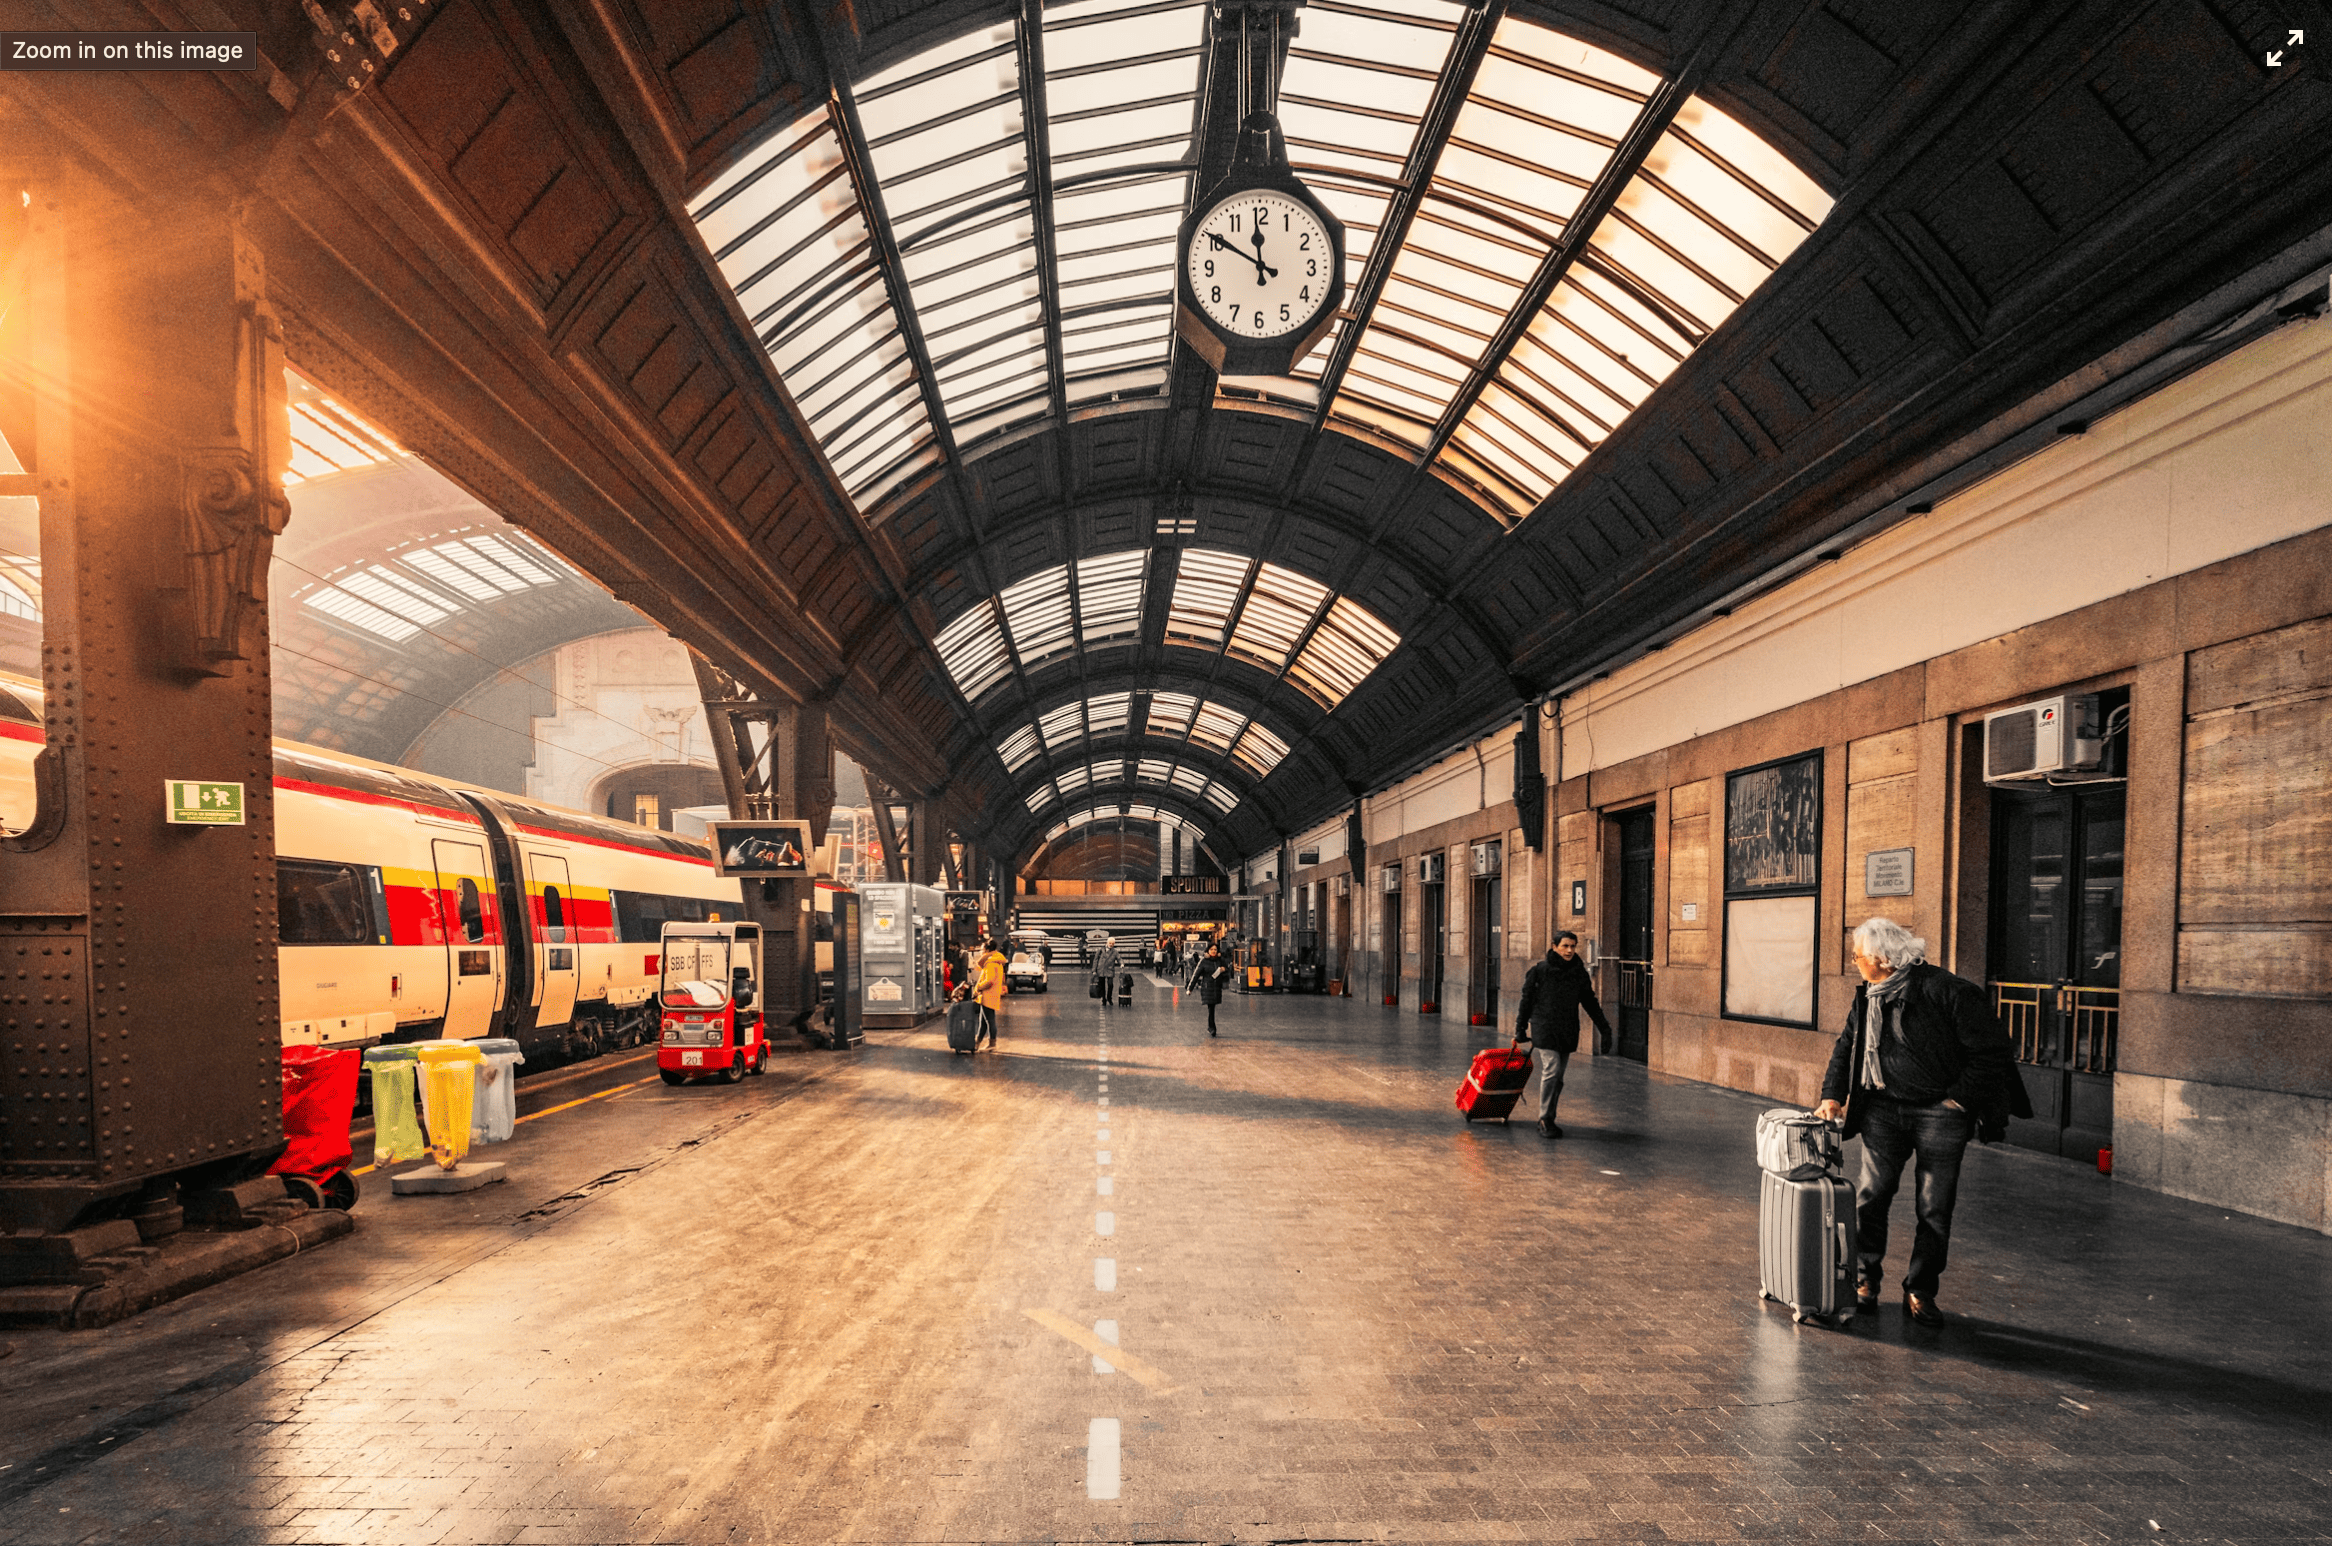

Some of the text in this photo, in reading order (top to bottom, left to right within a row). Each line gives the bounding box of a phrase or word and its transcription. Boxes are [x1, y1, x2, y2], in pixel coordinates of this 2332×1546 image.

[1229, 214, 1241, 232] 11
[1252, 207, 1269, 225] 12
[1283, 214, 1289, 232] 1
[1209, 234, 1224, 252] 10
[1300, 233, 1310, 251] 2
[1204, 260, 1214, 278] 9
[1306, 259, 1316, 277] 3
[1211, 285, 1221, 303] 8
[1299, 285, 1310, 303] 4
[1229, 304, 1240, 322] 7
[1254, 311, 1264, 329] 6
[1280, 304, 1290, 322] 5
[370, 868, 381, 893] 1
[1171, 877, 1219, 892] SPONTINI
[609, 890, 616, 908] 1
[1575, 886, 1583, 909] B
[1178, 910, 1210, 919] PIZZA
[670, 956, 685, 971] SBB
[701, 954, 714, 968] FFS
